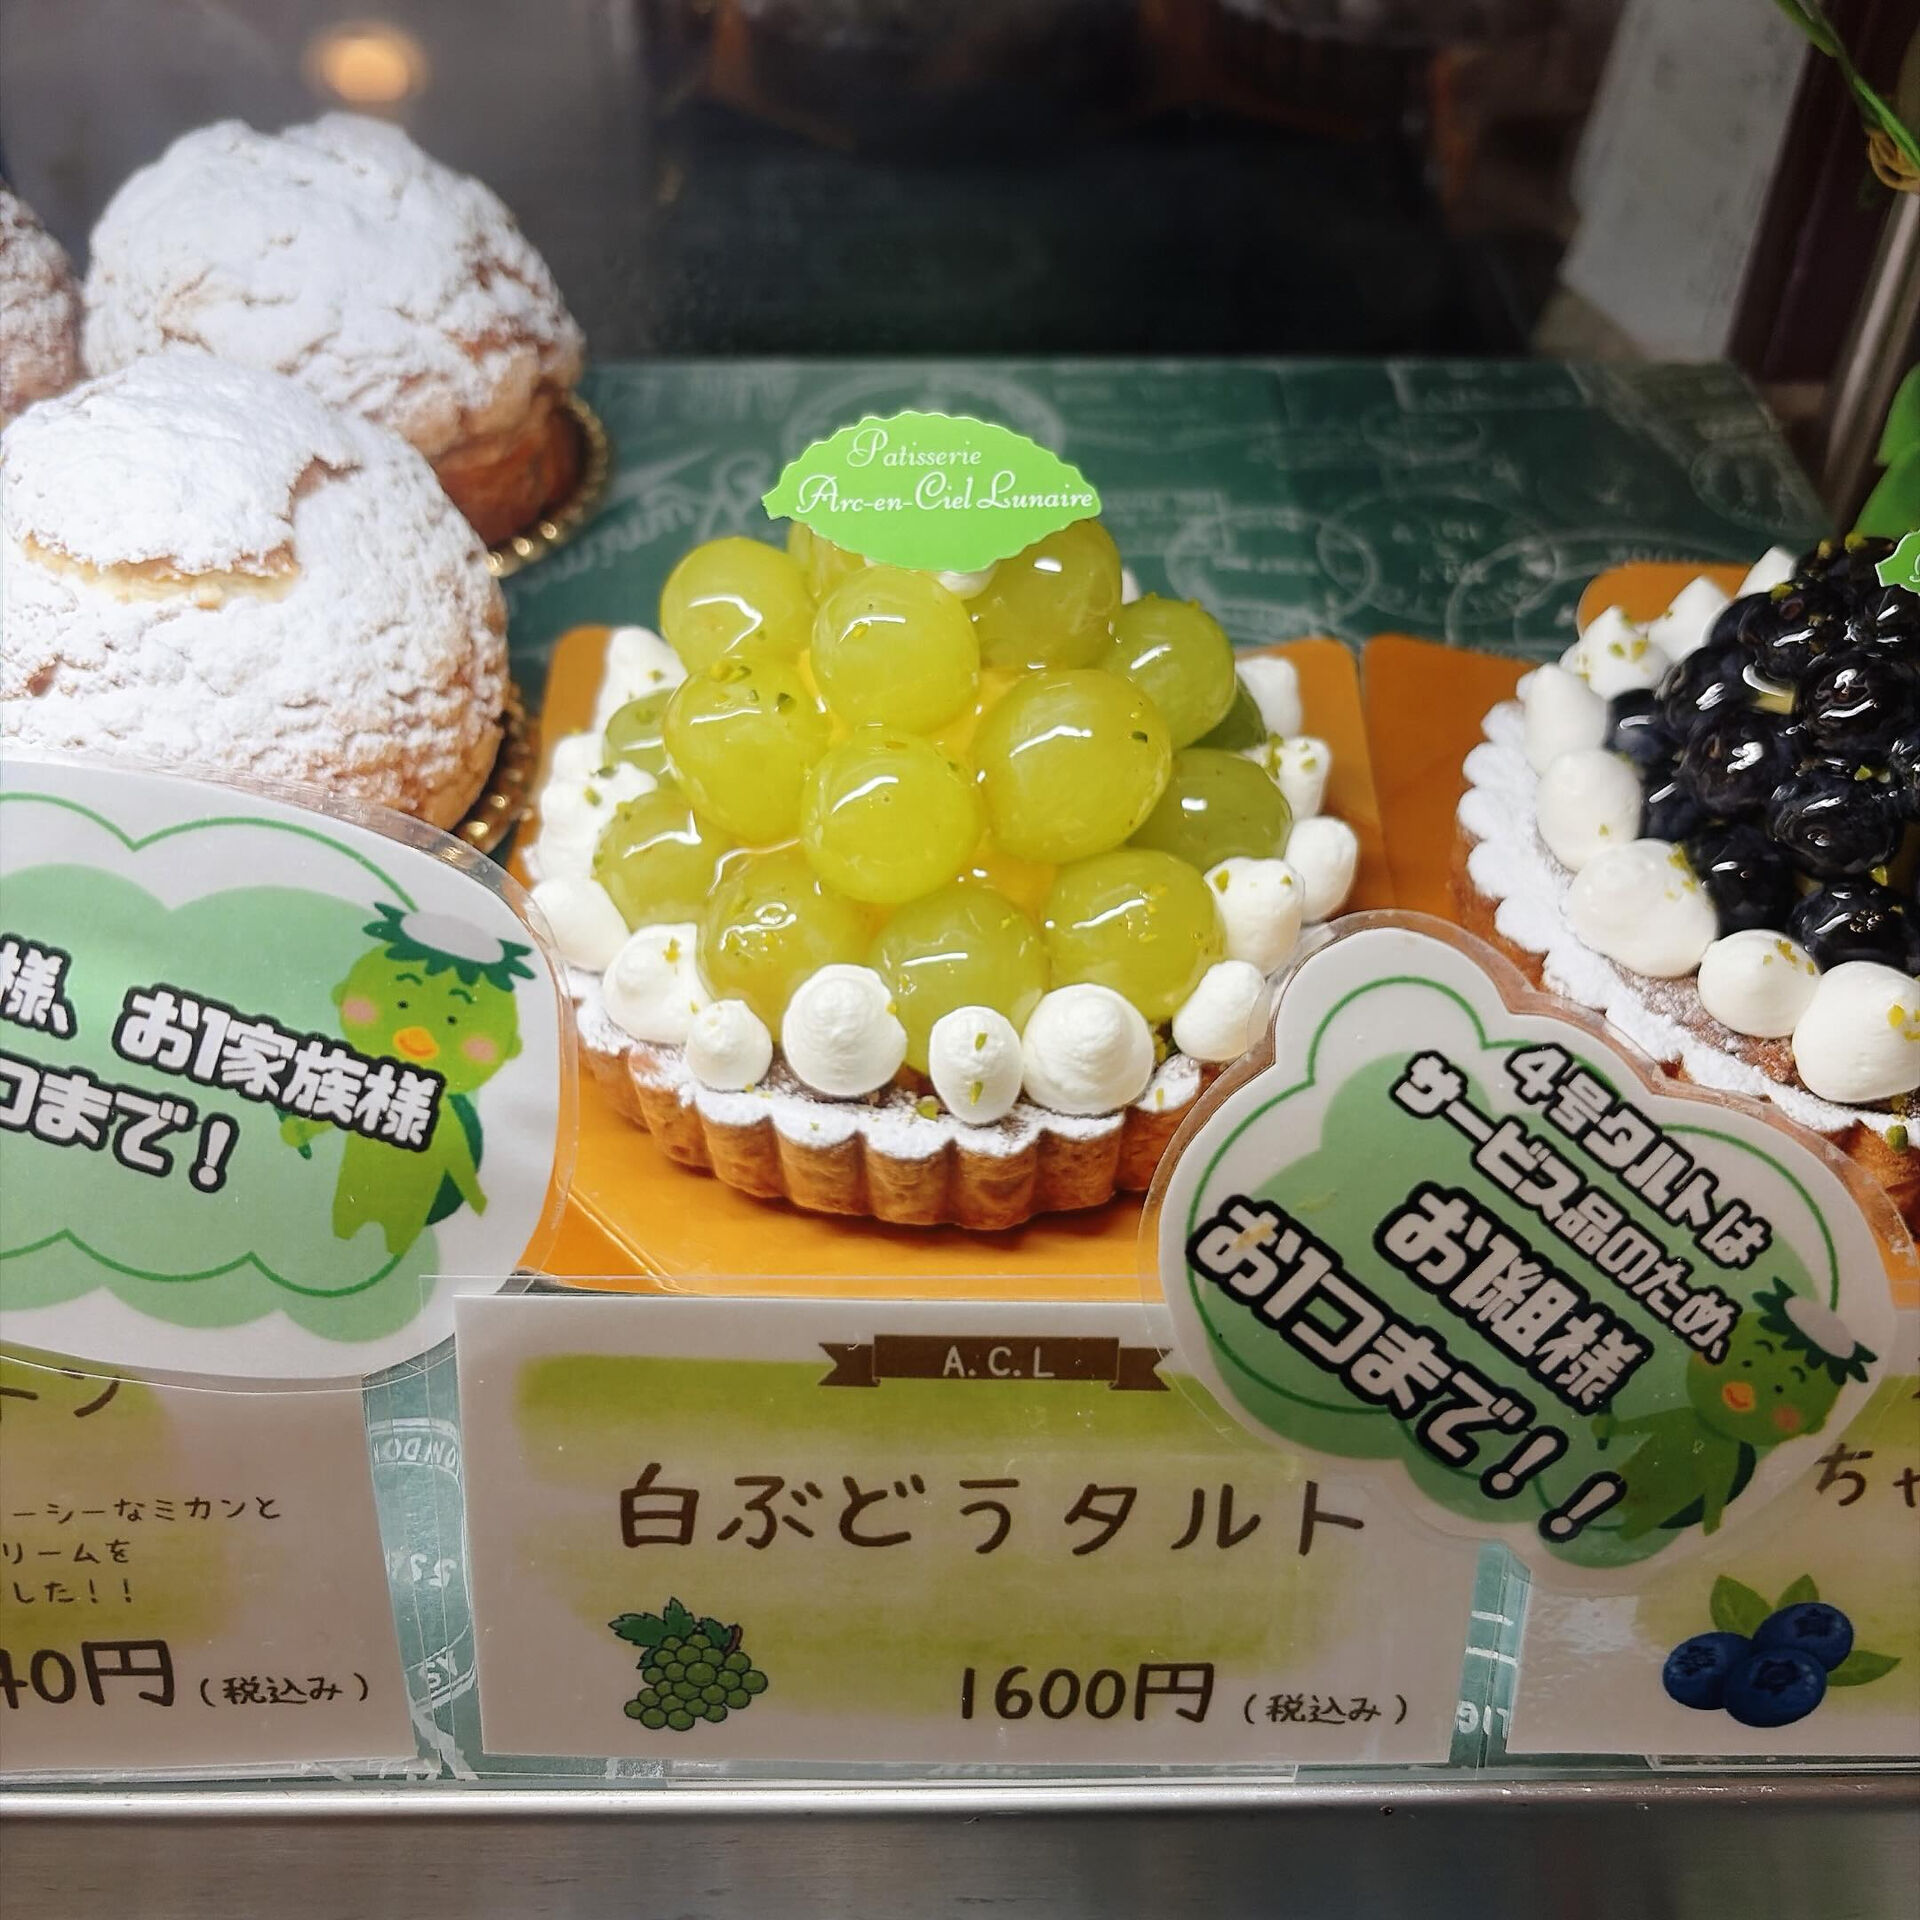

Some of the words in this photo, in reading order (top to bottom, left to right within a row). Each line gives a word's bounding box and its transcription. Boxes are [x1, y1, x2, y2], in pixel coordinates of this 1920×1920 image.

[847, 427, 982, 468] Patisserie
[796, 471, 972, 514] Arc-en-Ciel
[978, 470, 1093, 509] Lunaire
[113, 983, 445, 1152] お1家族様
[1506, 1044, 1771, 1269] 4号タルトは
[1390, 1050, 1742, 1364] サービス品のため、
[1375, 1182, 1653, 1415] お1組様
[942, 1345, 1055, 1378] A.C.L
[13, 1497, 280, 1524] ーシーなミカンと
[620, 1463, 1364, 1556] 白ぶどうタルト
[3, 1539, 130, 1564] リームを
[200, 1672, 368, 1707] （税込み）
[962, 1663, 1214, 1722] 1600円
[1244, 1694, 1407, 1725] （税込み）
